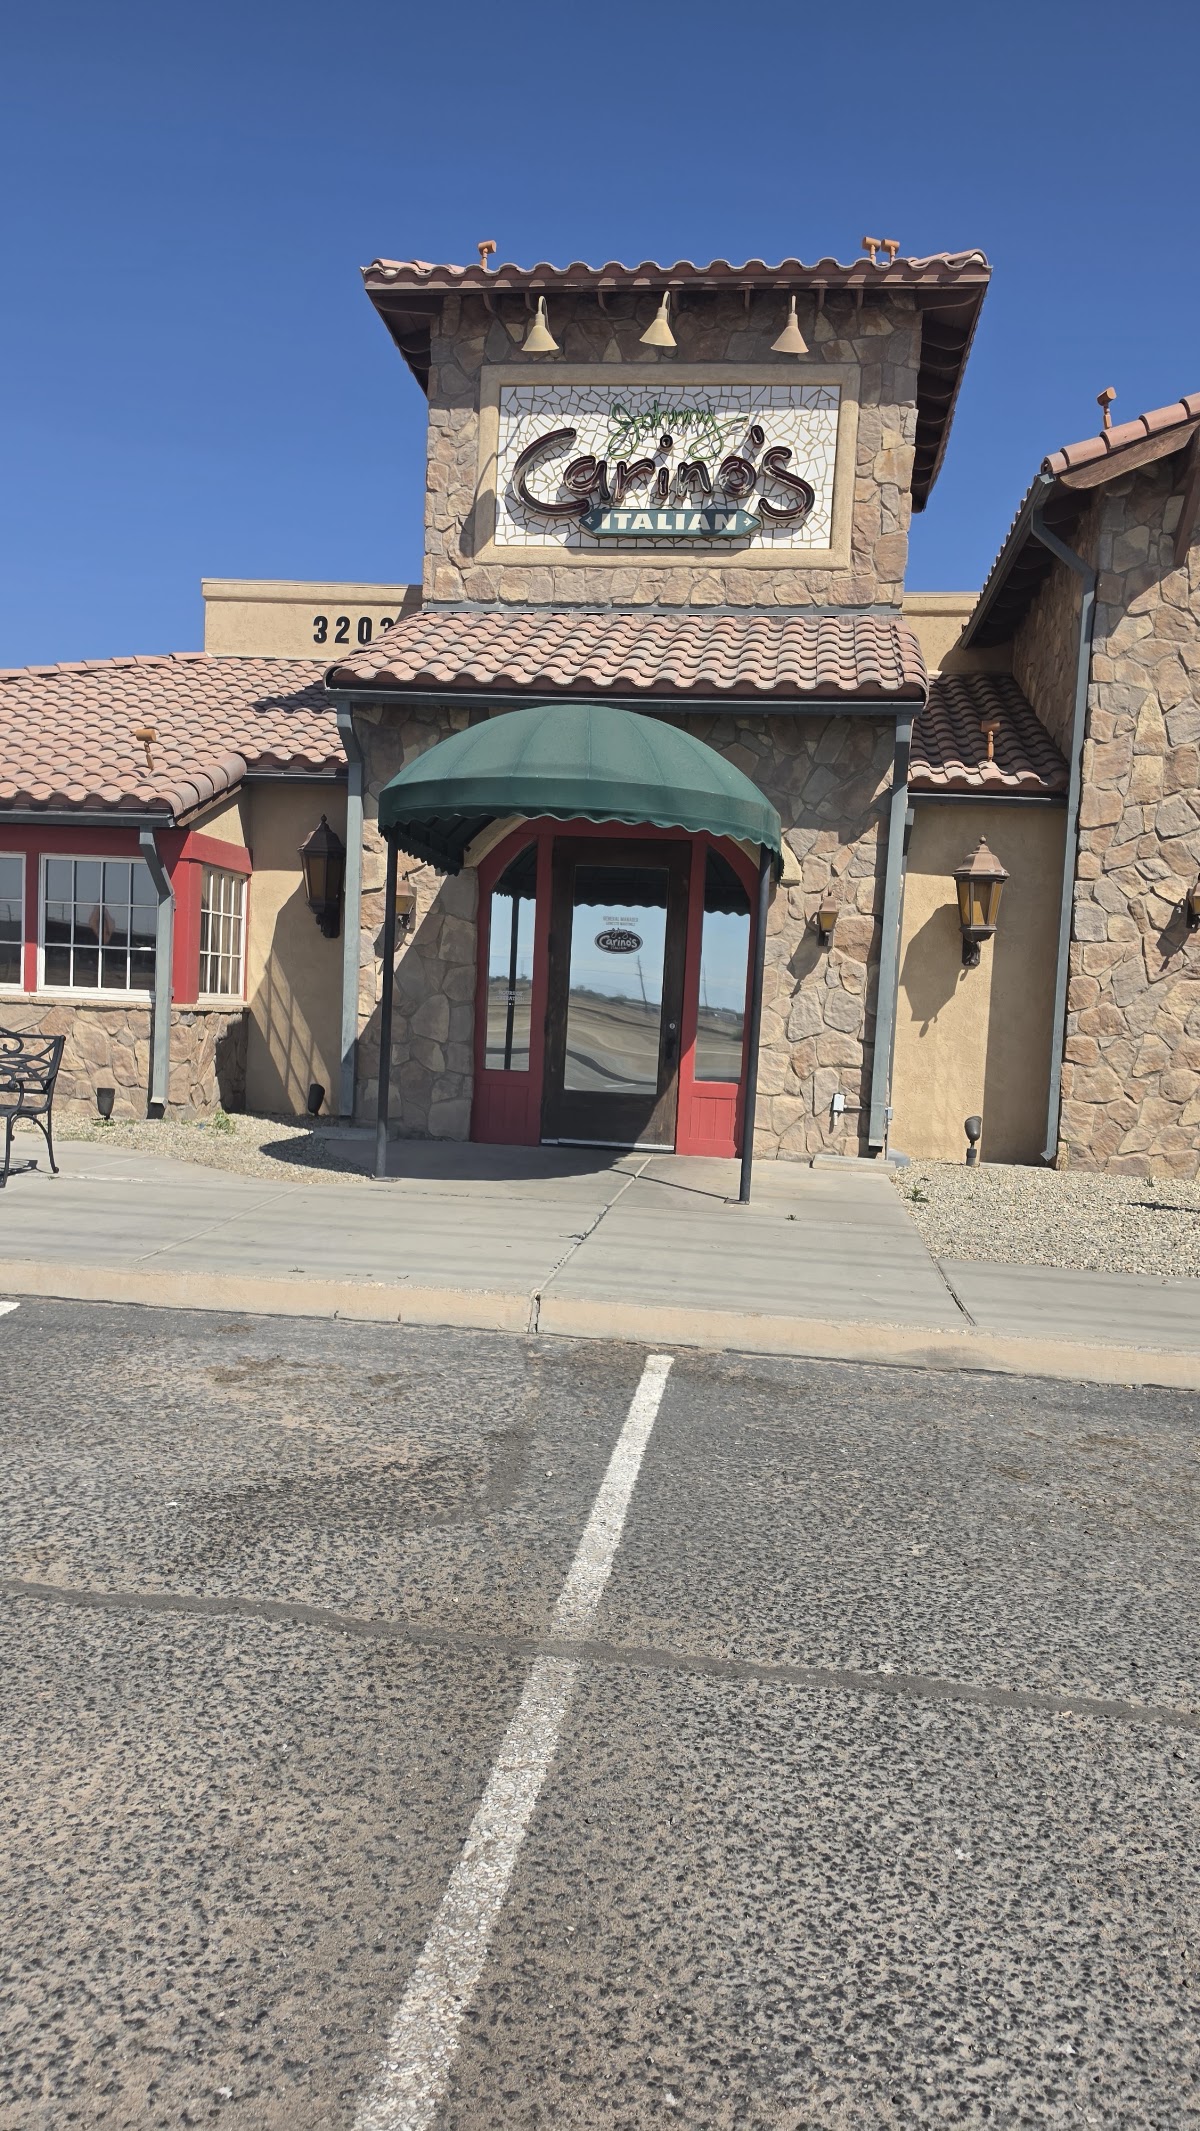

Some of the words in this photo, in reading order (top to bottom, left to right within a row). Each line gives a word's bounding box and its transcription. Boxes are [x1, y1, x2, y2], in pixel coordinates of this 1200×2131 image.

[512, 425, 816, 523] Carino's
[601, 513, 737, 531] ITALIAN
[600, 935, 637, 948] Carino's
